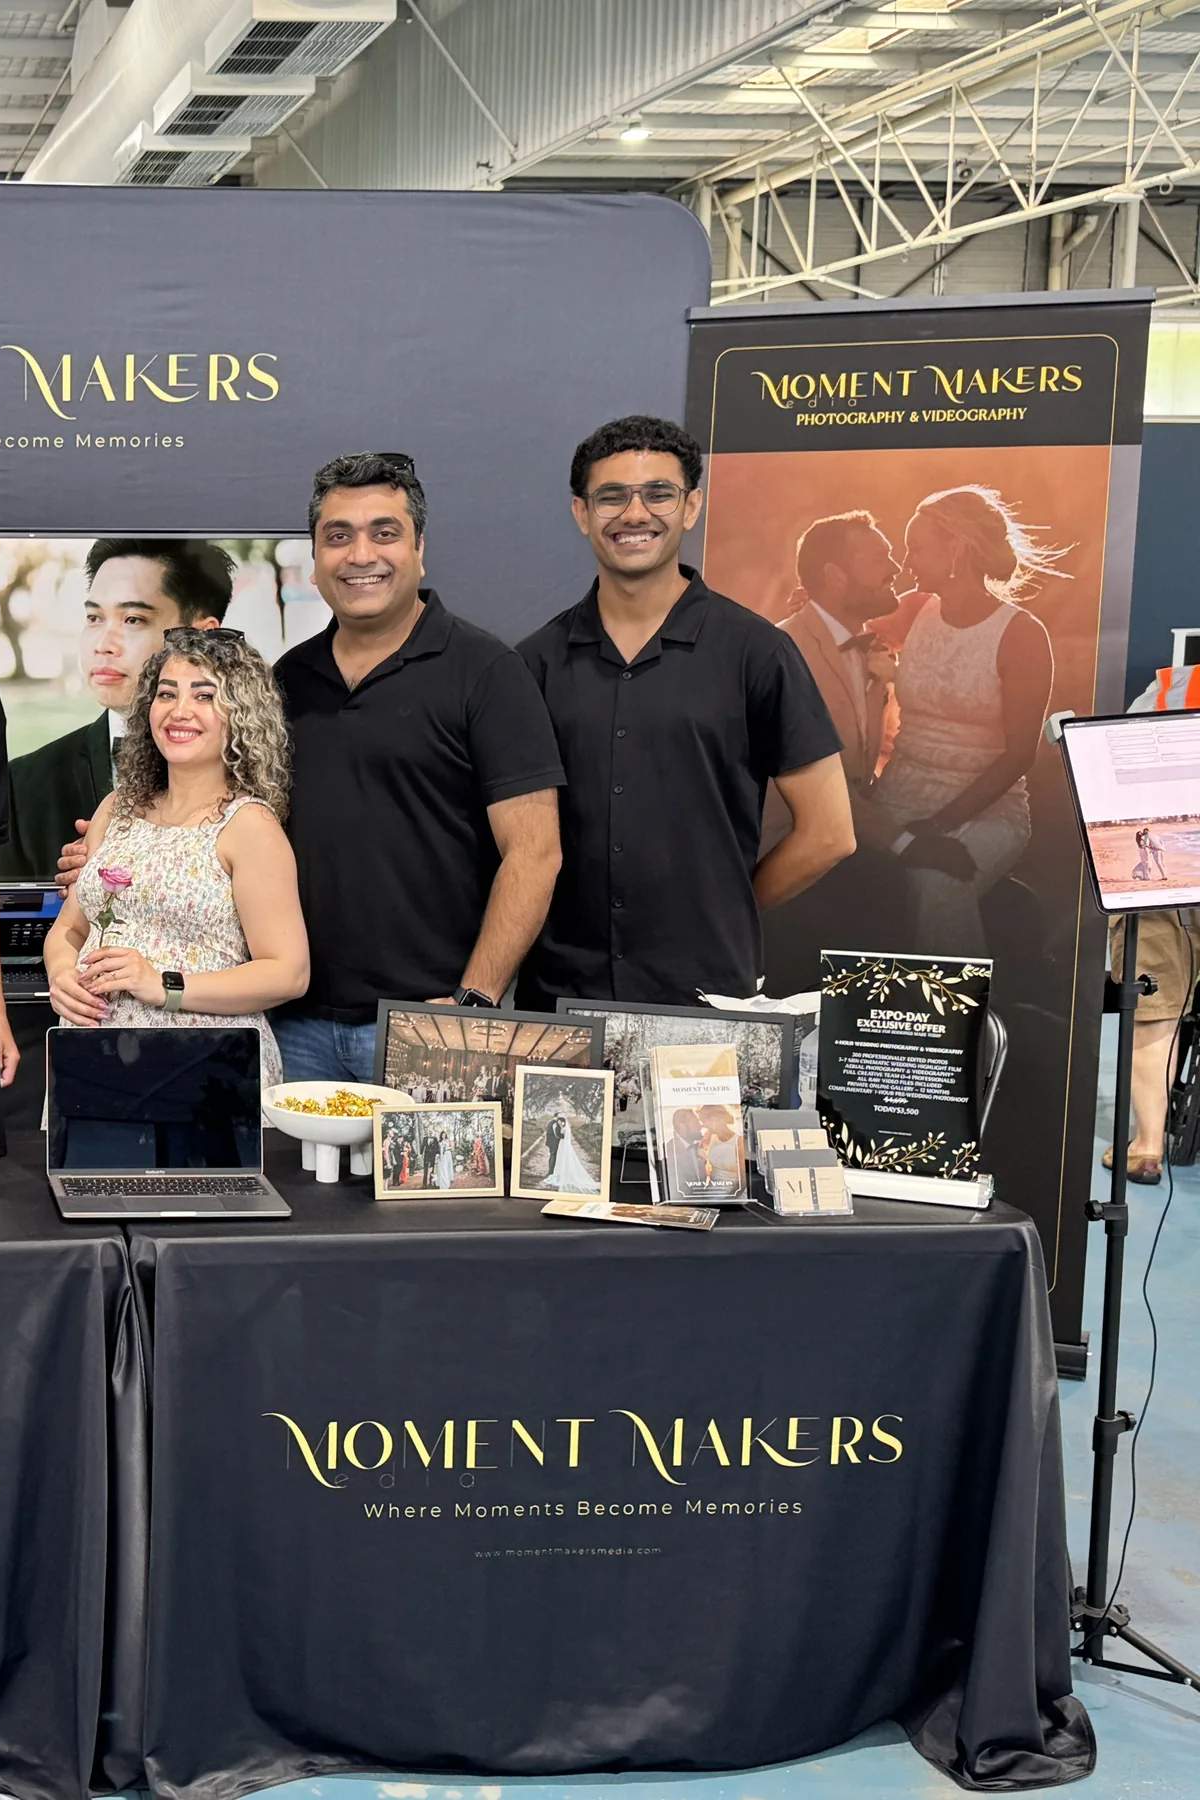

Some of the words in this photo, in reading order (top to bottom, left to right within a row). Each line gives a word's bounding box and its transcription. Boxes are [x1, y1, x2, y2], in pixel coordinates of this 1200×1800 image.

[0, 345, 280, 420] MAKERS
[750, 370, 917, 408] MOMENT
[924, 364, 1082, 404] MAKERS
[796, 410, 906, 426] PHOTOGRAPHY
[910, 412, 919, 422] &
[922, 407, 1027, 422] VIDEOGRAPHY
[76, 433, 185, 449] Memories
[870, 1009, 930, 1022] EXPO-DAY
[856, 1019, 912, 1030] EXCLUSIVE
[914, 1023, 946, 1034] OFFER
[828, 1085, 872, 1094] COMPLIMENTARY
[933, 1095, 969, 1103] PHOTOSHOOT
[262, 1413, 594, 1488] MOMENT
[608, 1409, 904, 1486] MAKERS
[364, 1503, 442, 1518] Where
[455, 1502, 564, 1518] Moments
[578, 1501, 673, 1516] Become
[686, 1499, 802, 1514] Memories
[474, 1546, 662, 1558] www.momentmakersmedia.com
